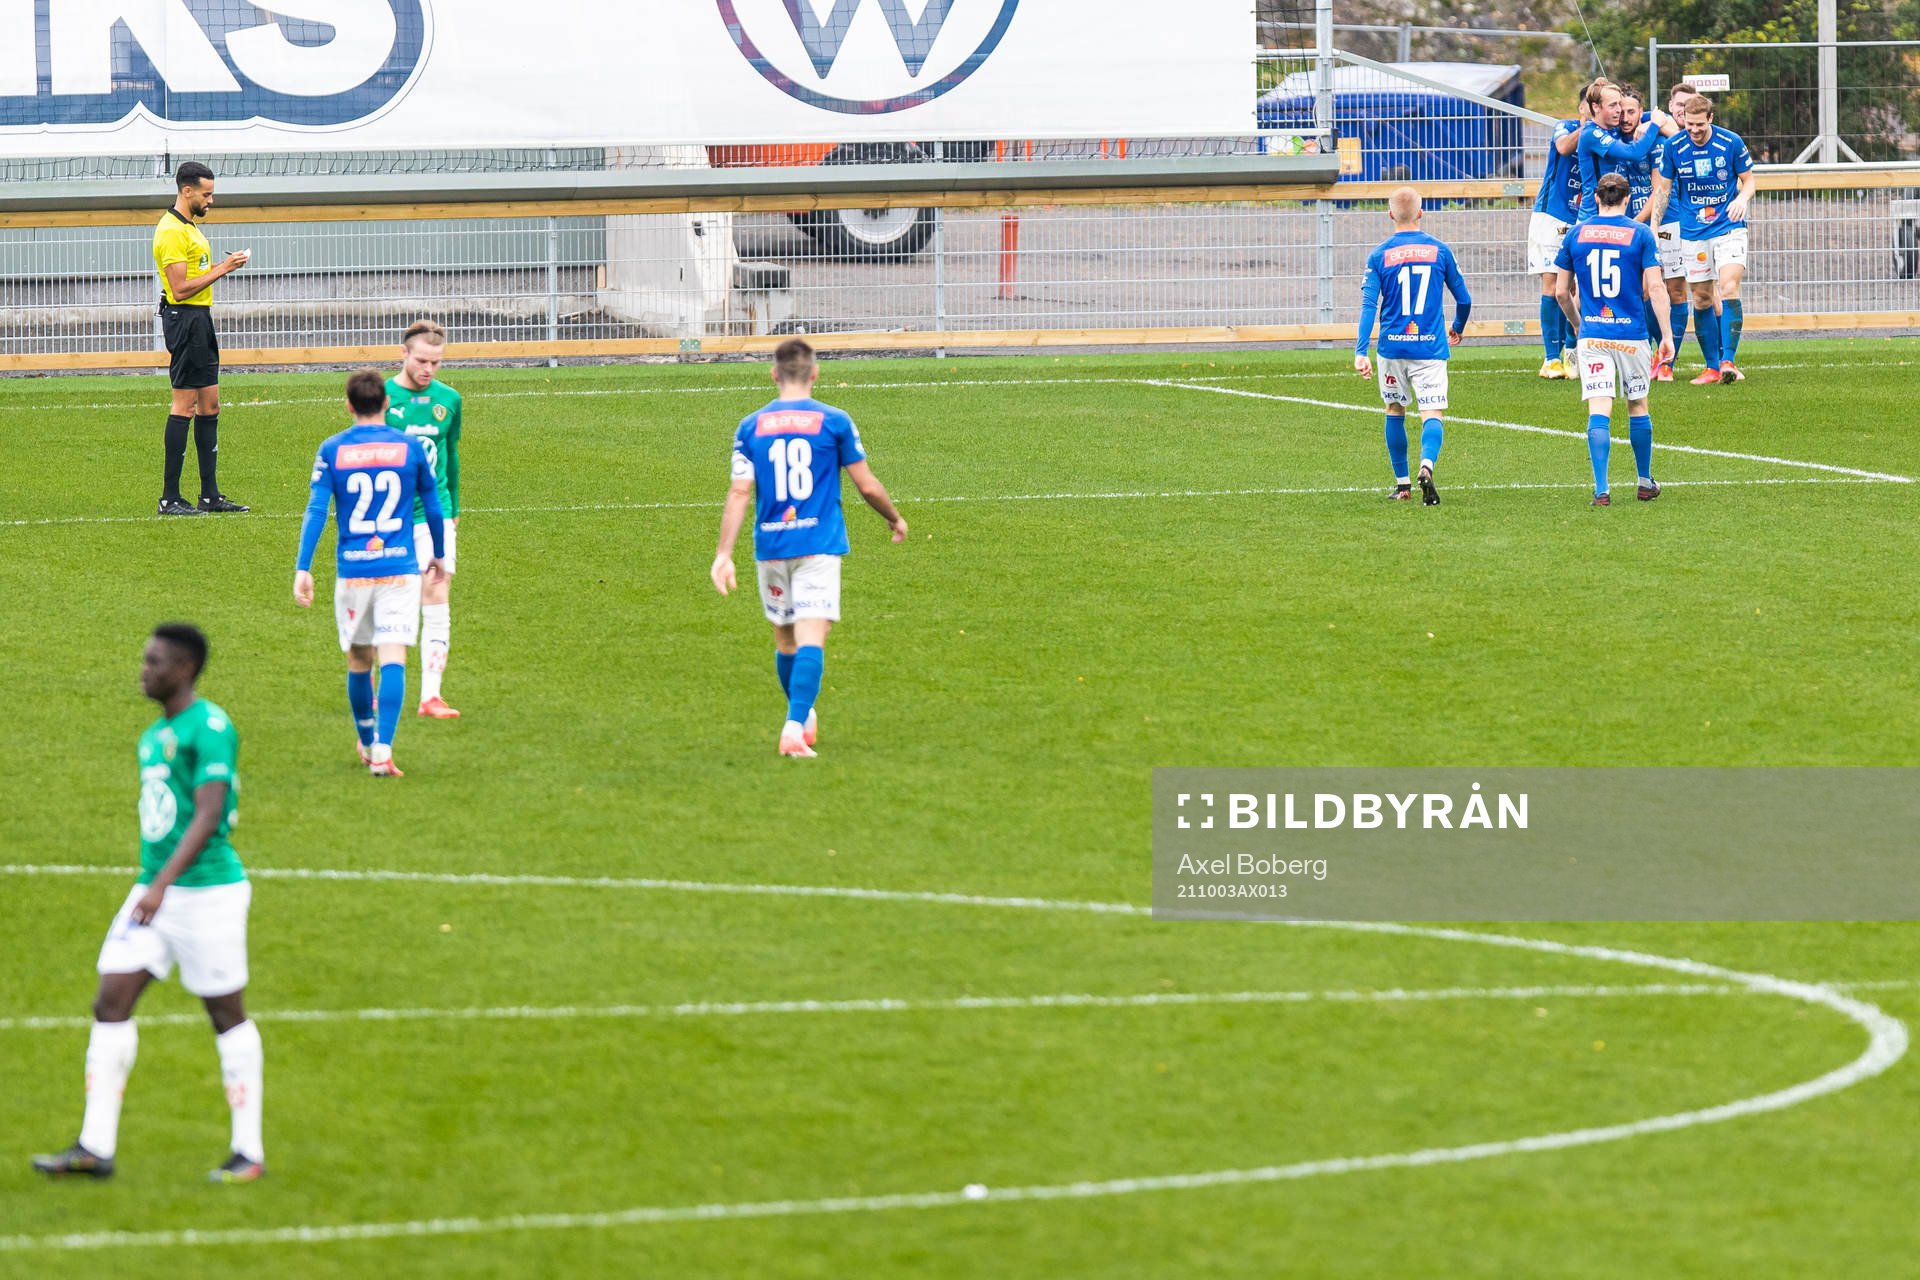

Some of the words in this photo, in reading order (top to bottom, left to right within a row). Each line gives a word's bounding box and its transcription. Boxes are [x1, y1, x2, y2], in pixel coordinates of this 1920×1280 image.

[1691, 195, 1727, 204] Cernera
[1584, 228, 1628, 239] elcenter
[1390, 247, 1432, 260] elcenter
[1586, 248, 1620, 298] 15
[1398, 265, 1431, 316] 17
[1587, 339, 1638, 354] Passera
[768, 438, 814, 502] 18
[346, 470, 403, 534] 22
